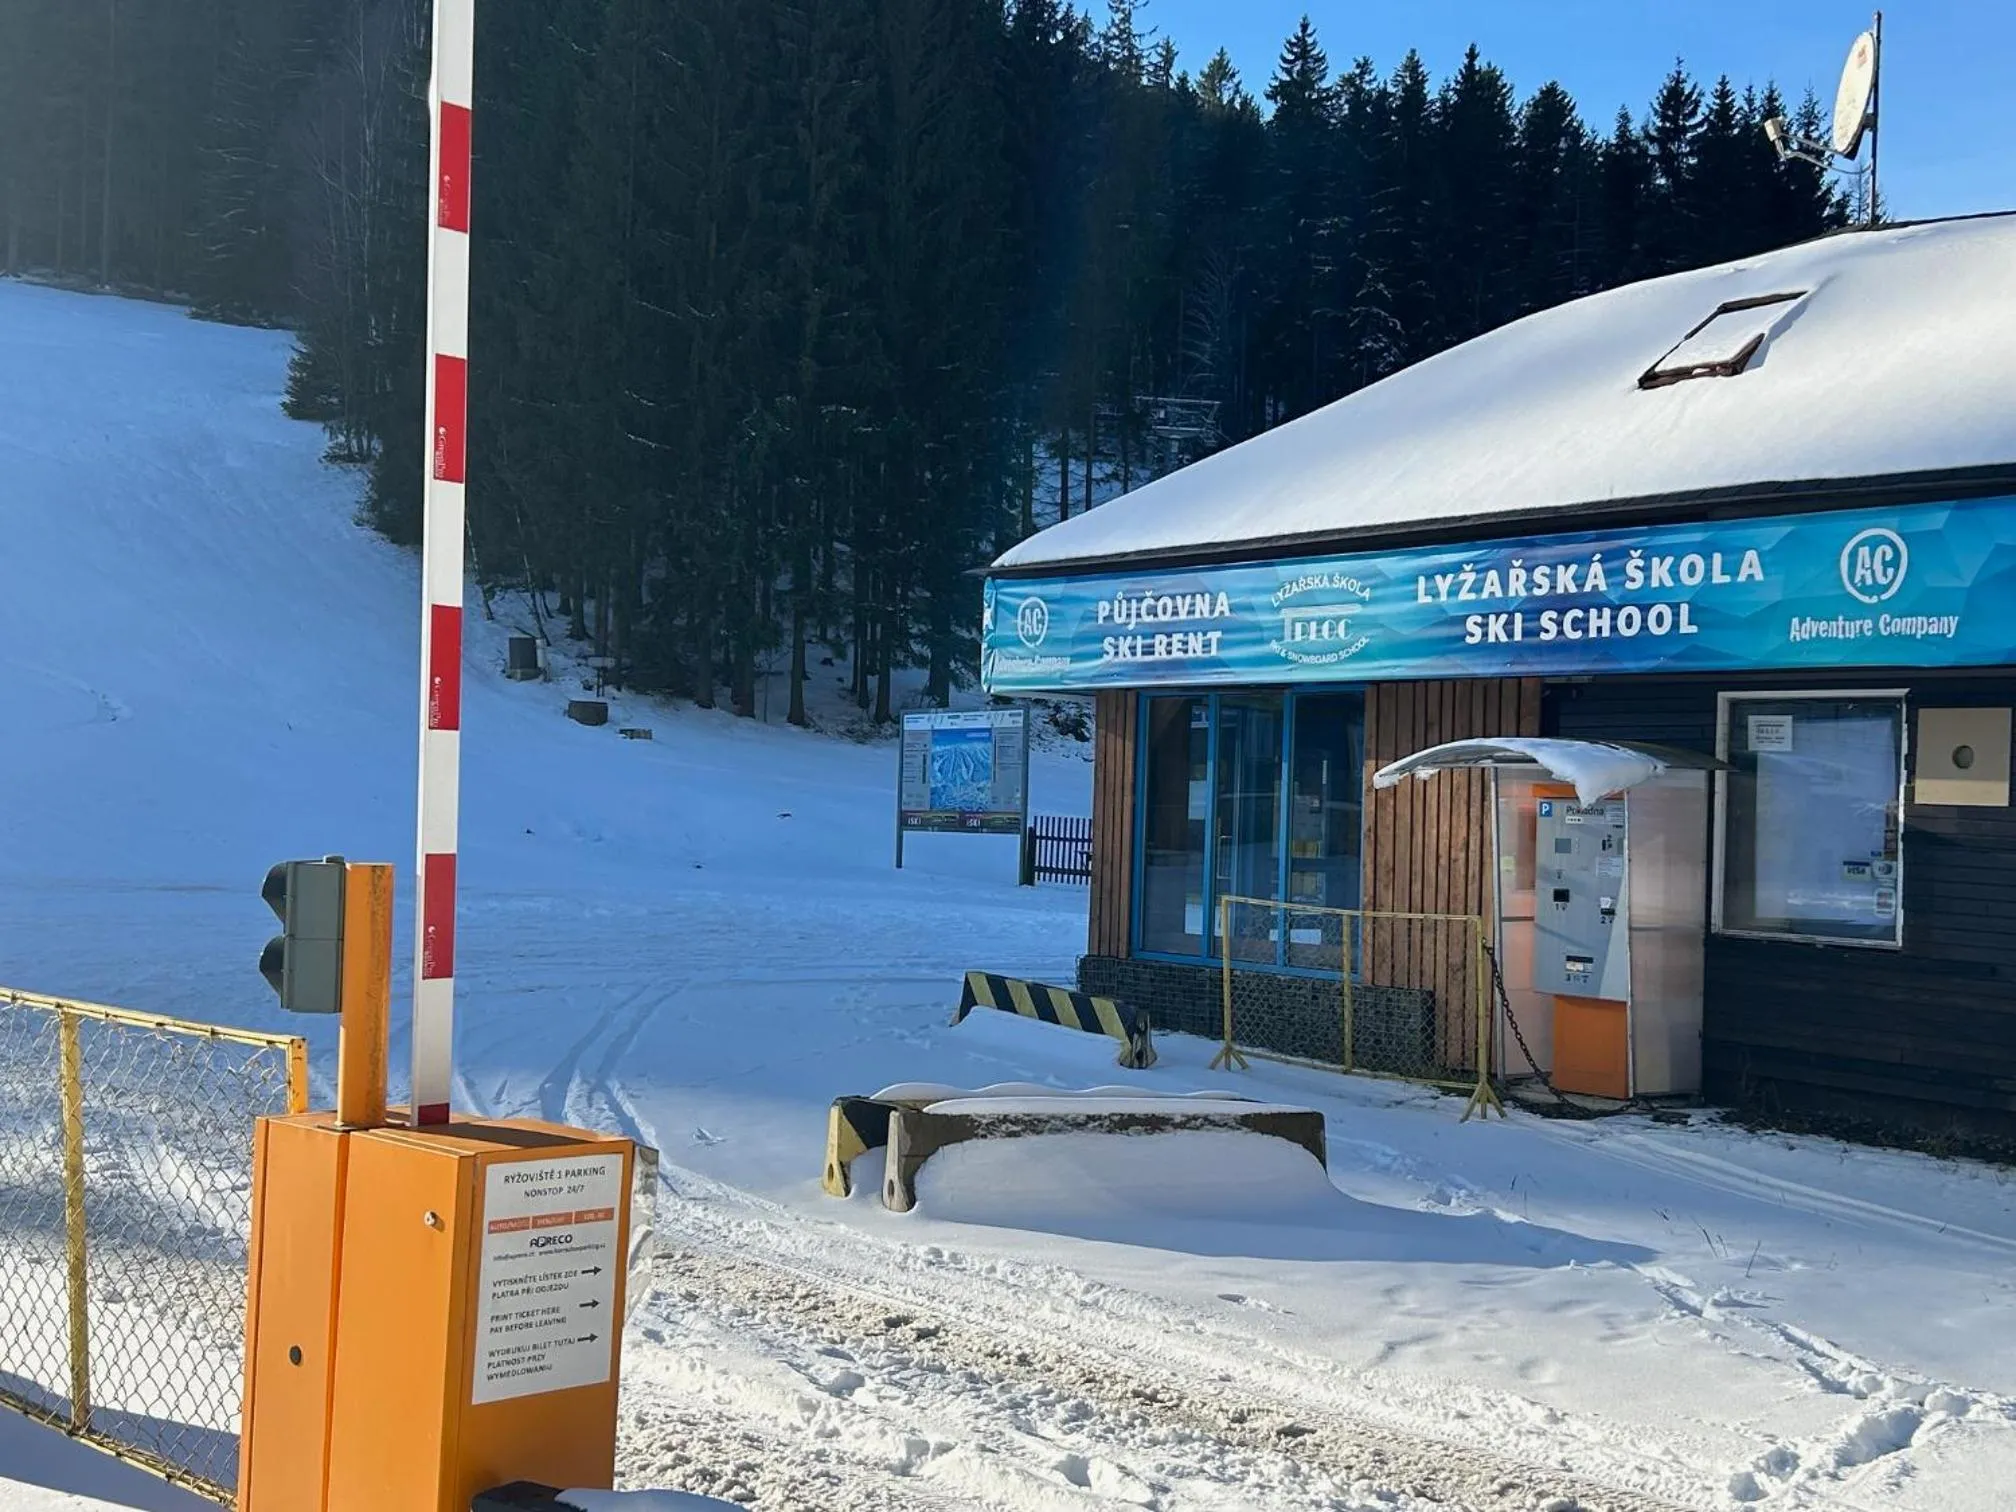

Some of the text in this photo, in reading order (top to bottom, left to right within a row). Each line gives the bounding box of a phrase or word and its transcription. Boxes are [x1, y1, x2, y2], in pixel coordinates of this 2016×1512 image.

[1417, 549, 1765, 604] LYŽAŘSKÁ ŠKOLA
[1854, 544, 1894, 587] AC
[1332, 572, 1371, 602] ŠKOLA
[1024, 608, 1043, 636] AC
[1097, 589, 1231, 631] PŮJČOVNA
[1464, 602, 1699, 645] SKI SCHOOL
[1789, 613, 1960, 642] Adventure Company
[1102, 631, 1222, 661] SKI RENT
[1542, 803, 1550, 815] P
[565, 1166, 606, 1178] PARKING
[524, 1184, 585, 1198] NONSTOP 24/7
